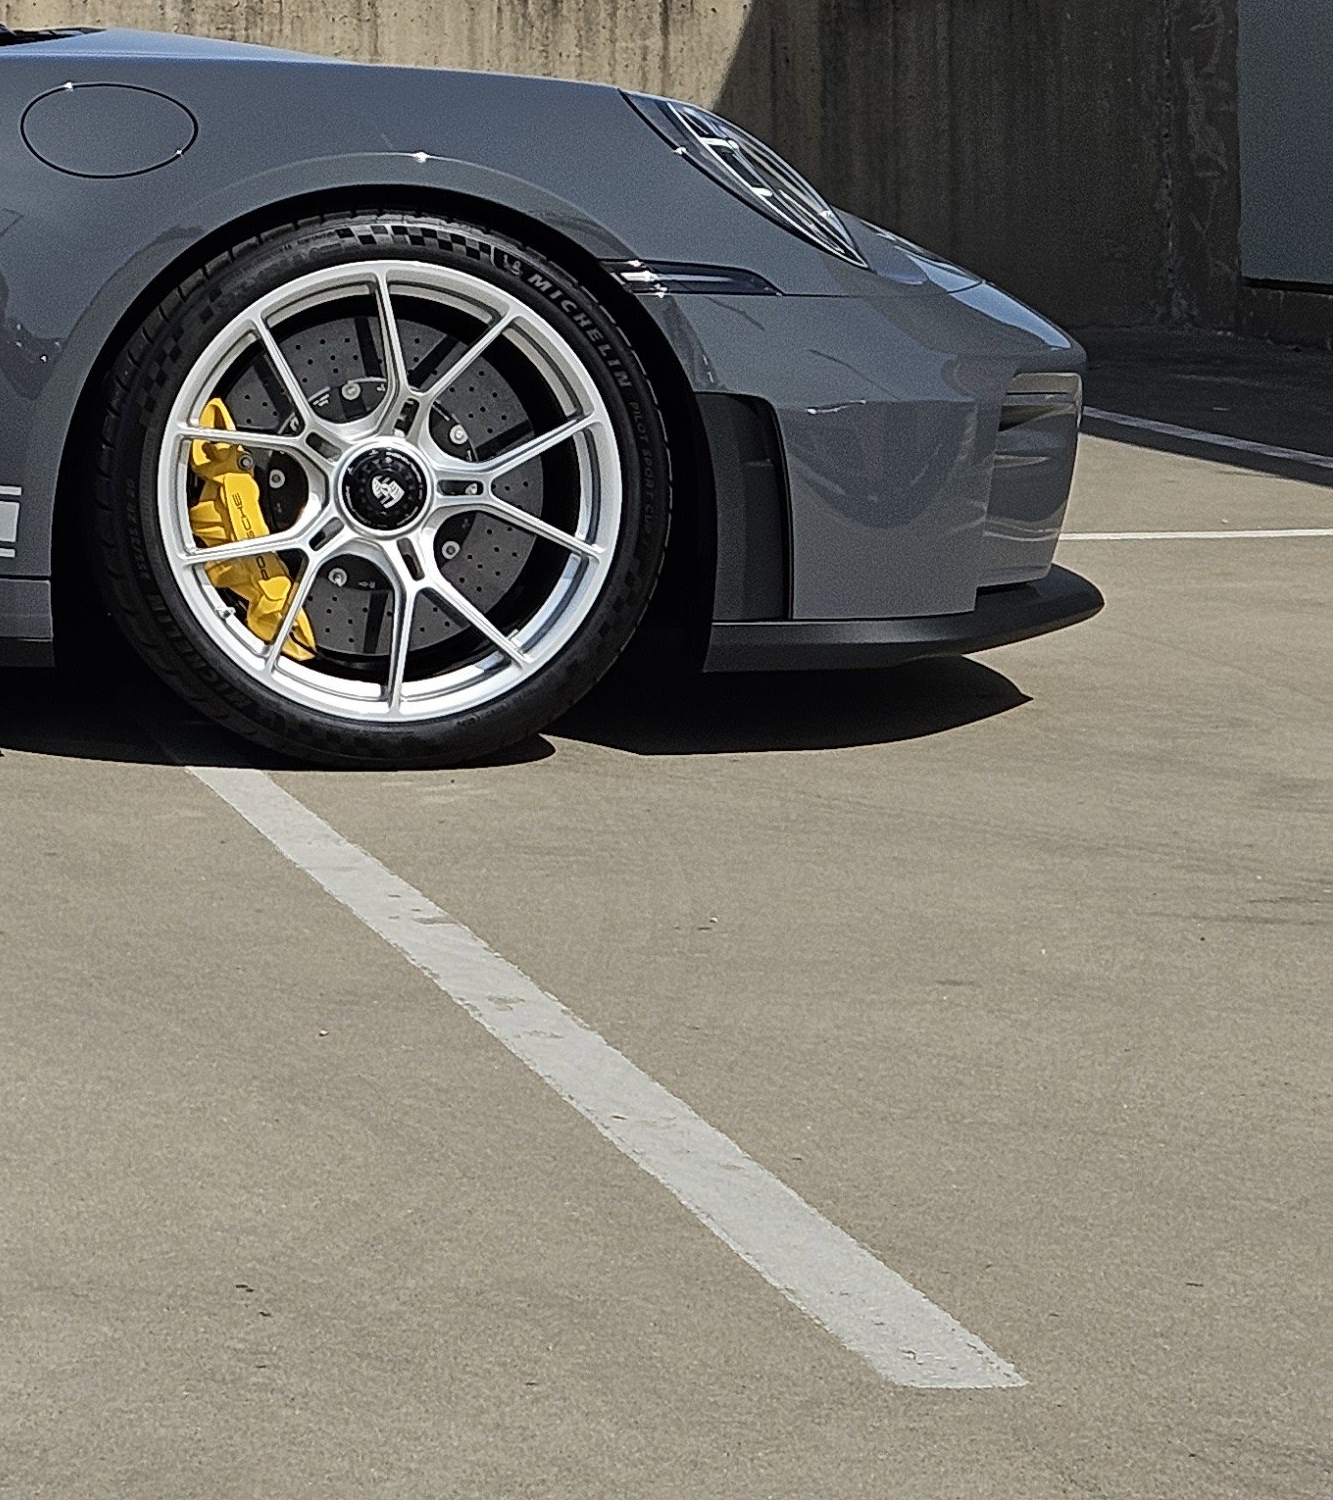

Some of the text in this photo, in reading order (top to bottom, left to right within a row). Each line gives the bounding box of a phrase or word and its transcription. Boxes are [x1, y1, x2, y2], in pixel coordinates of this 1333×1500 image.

[525, 268, 632, 391] MICHELIN
[627, 397, 650, 445] PILOT
[640, 445, 655, 499] SPORT
[231, 492, 271, 581] POSCHE
[641, 502, 655, 535] CUP
[145, 588, 253, 714] MICHELIN
